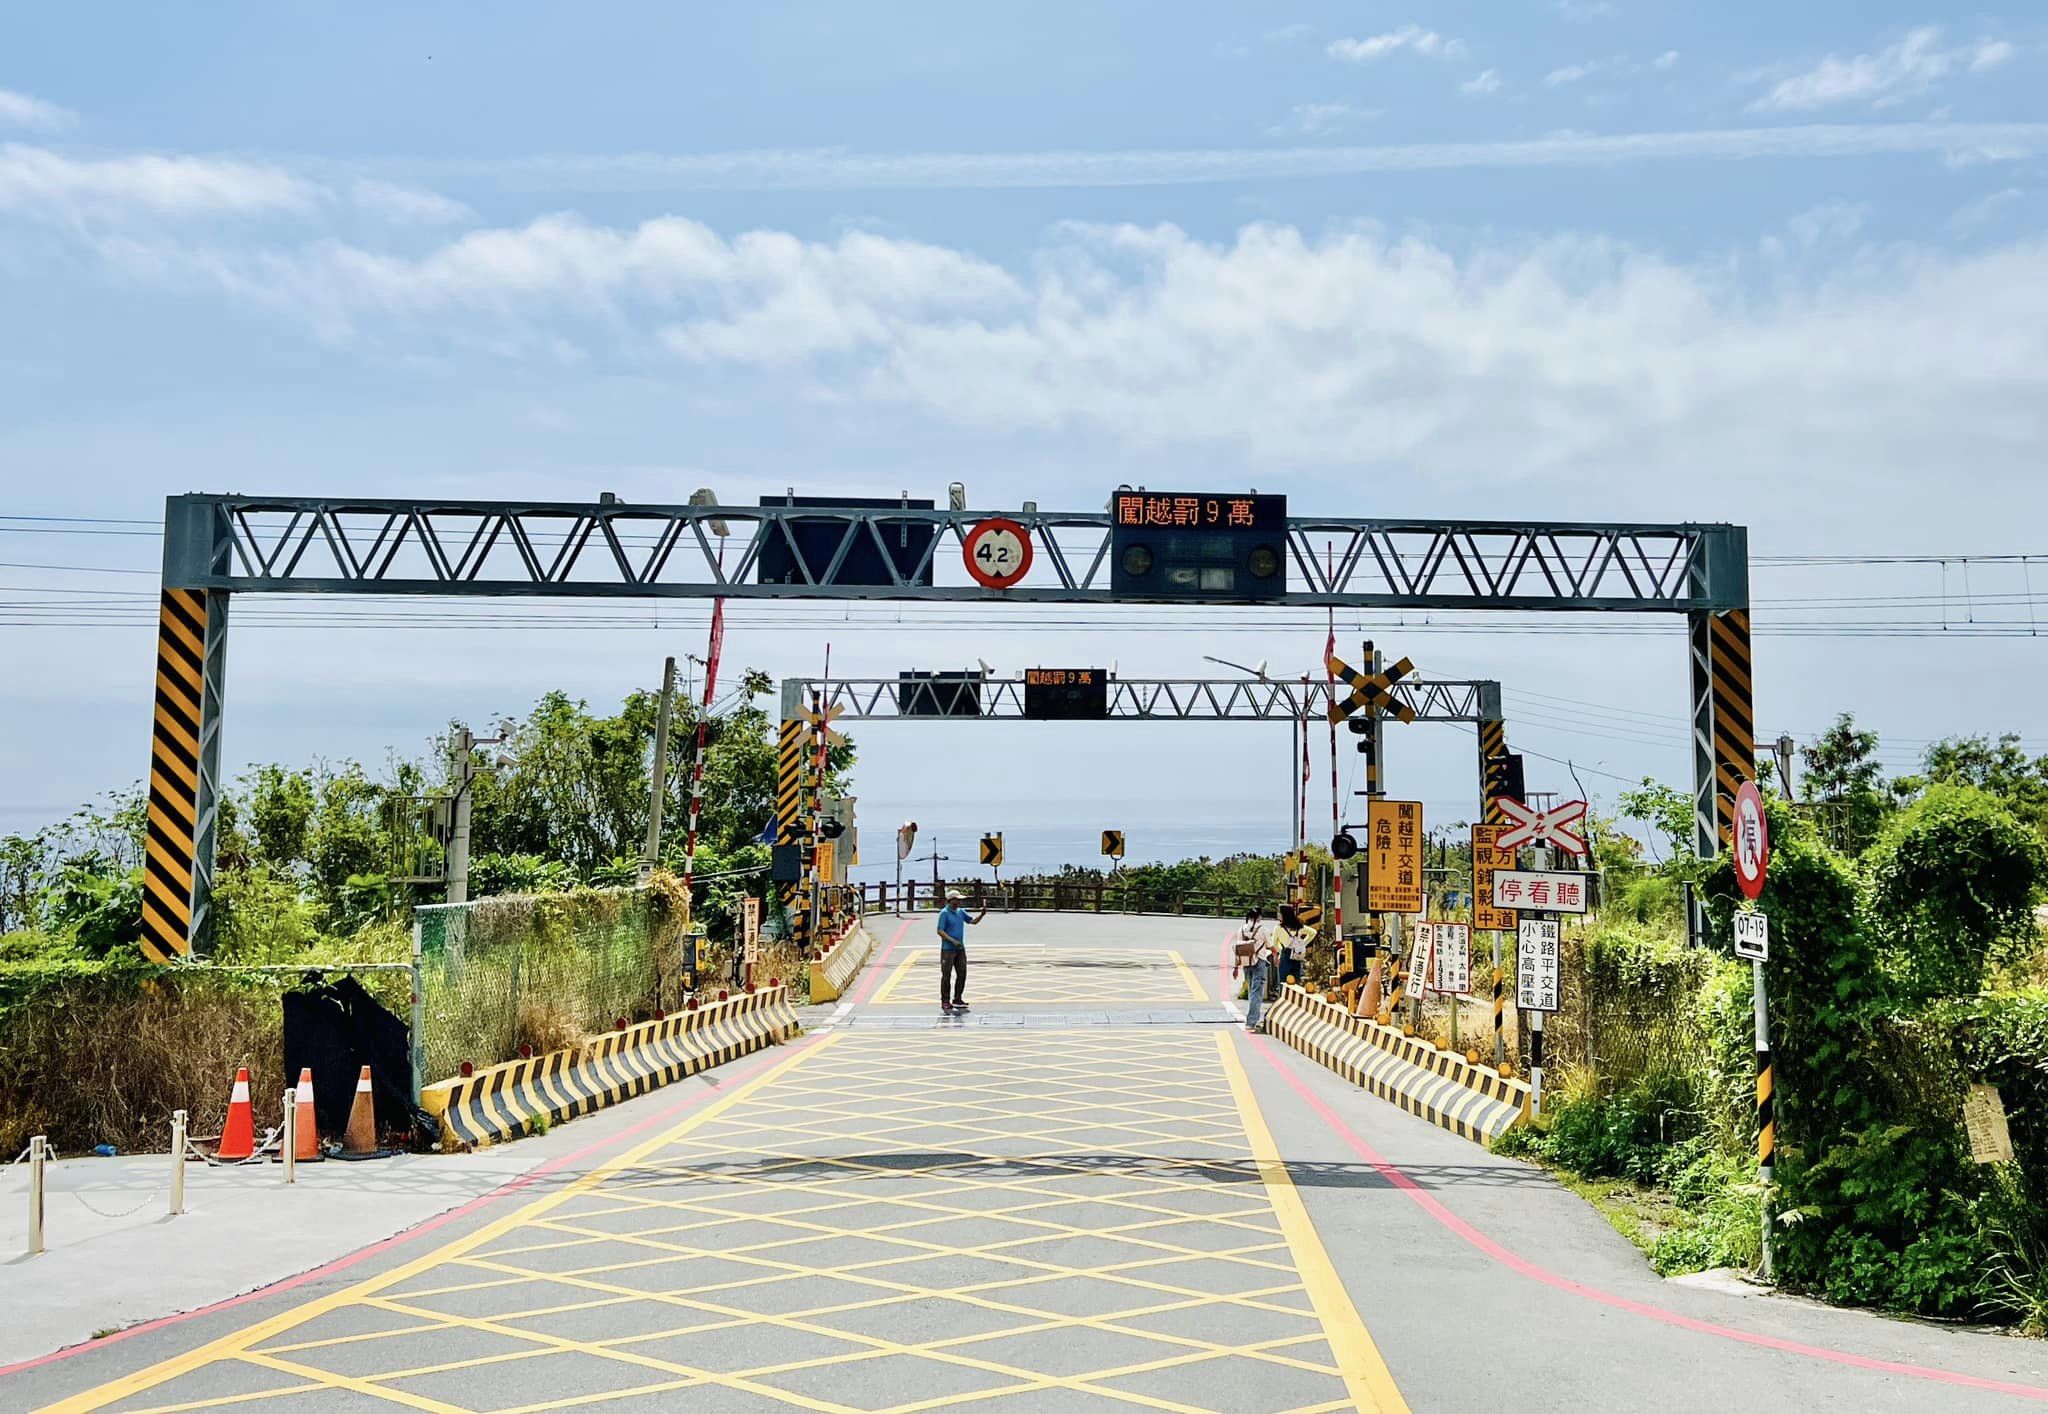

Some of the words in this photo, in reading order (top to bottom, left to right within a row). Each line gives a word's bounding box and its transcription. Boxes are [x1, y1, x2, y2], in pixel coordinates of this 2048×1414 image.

[1118, 496, 1255, 527] 闖越罰9萬
[976, 543, 1009, 563] 4.2
[1398, 804, 1413, 886] 闖越平交道
[1498, 878, 1580, 906] 停看聽
[1738, 916, 1764, 938] 07-19
[1410, 927, 1431, 994] 禁止通行
[1520, 922, 1537, 1008] 小心高壓電
[1539, 924, 1556, 1008] 鐵路平交道
